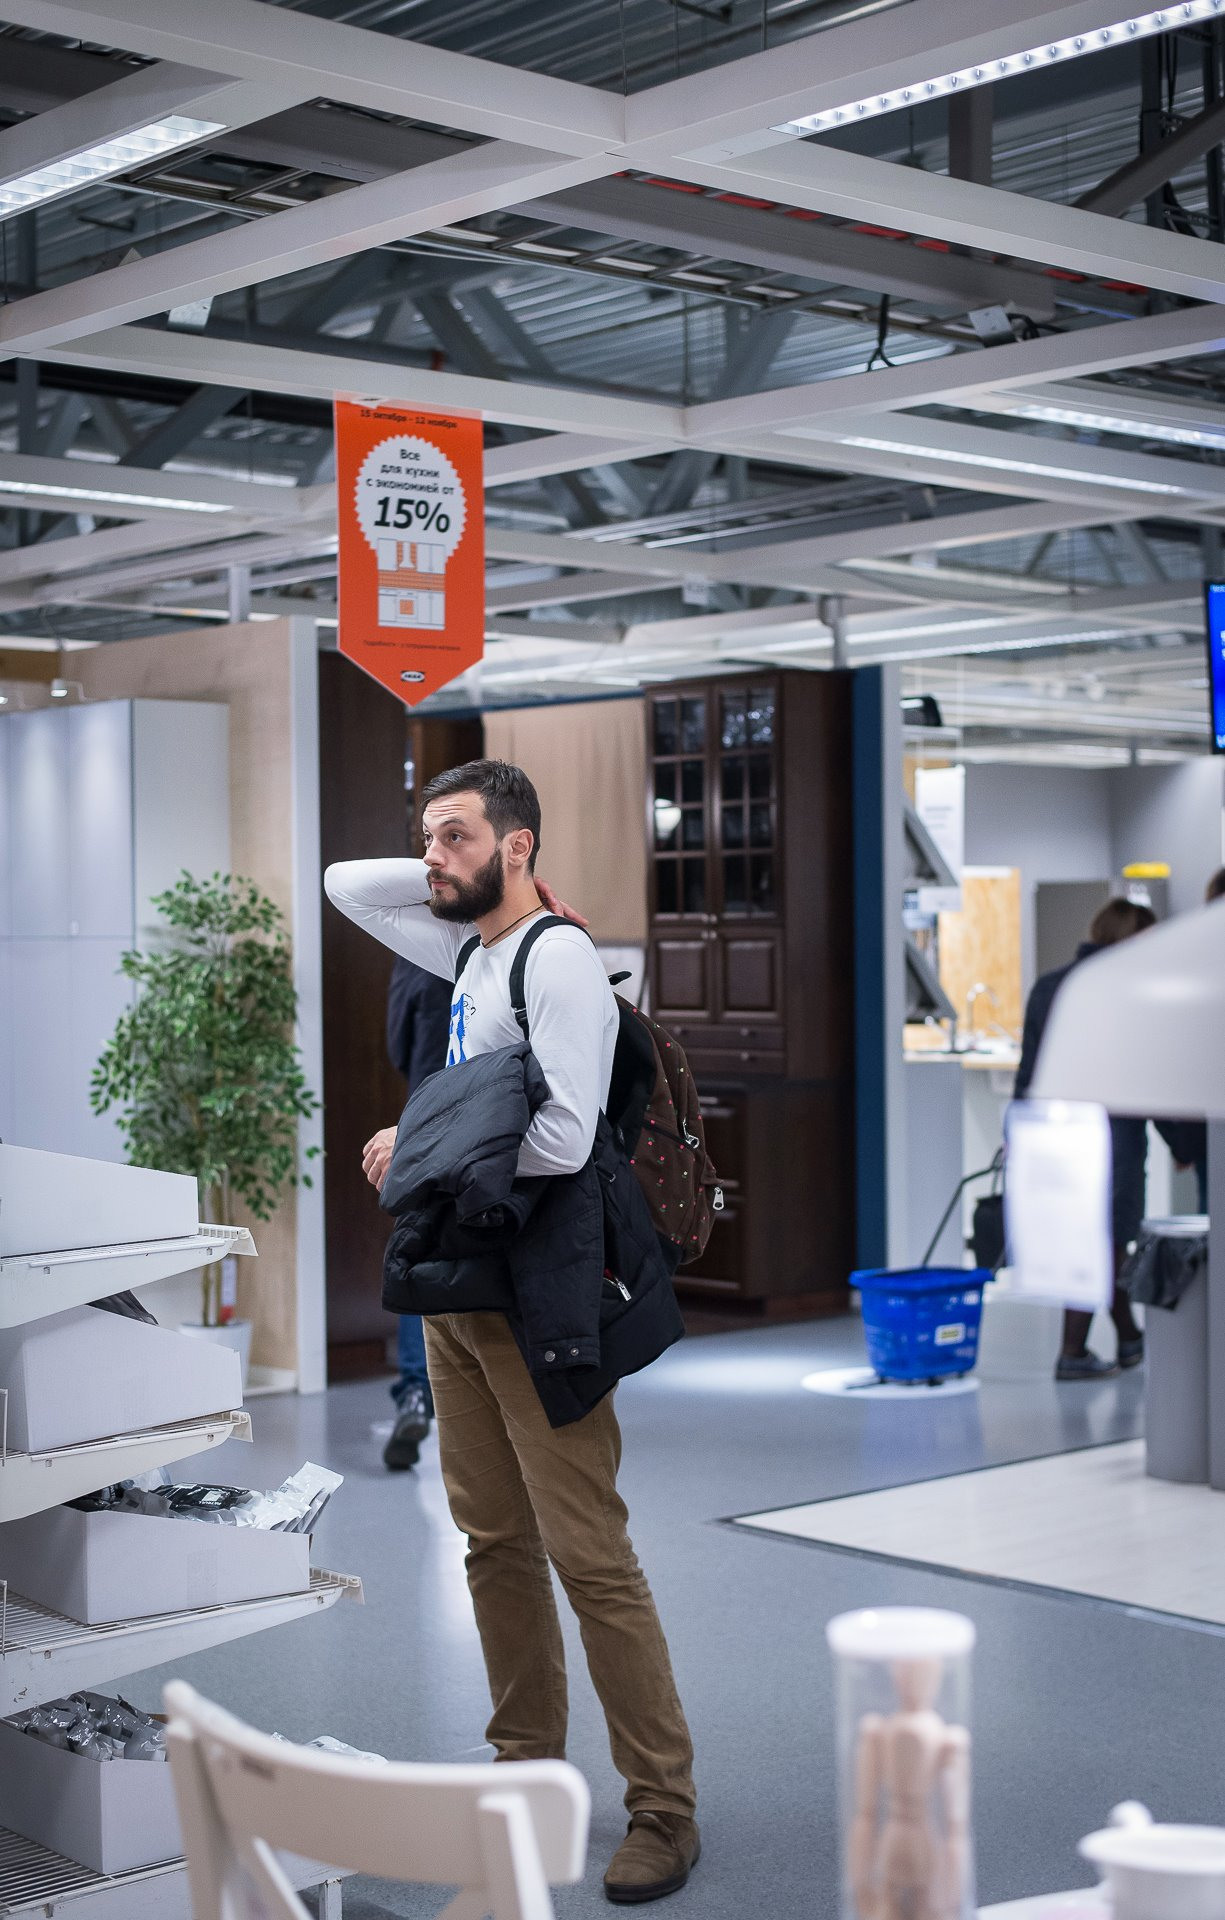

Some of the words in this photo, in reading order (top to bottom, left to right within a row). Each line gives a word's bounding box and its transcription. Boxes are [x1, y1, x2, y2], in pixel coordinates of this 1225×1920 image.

[360, 409, 371, 418] 15
[373, 412, 407, 423] октября
[415, 416, 426, 424] 12
[427, 420, 457, 429] ноября
[400, 449, 421, 461] Все
[380, 464, 402, 474] для
[405, 466, 440, 479] кухни
[366, 478, 372, 487] с
[376, 478, 440, 494] экономией
[442, 487, 455, 496] от
[374, 496, 451, 533] 15%
